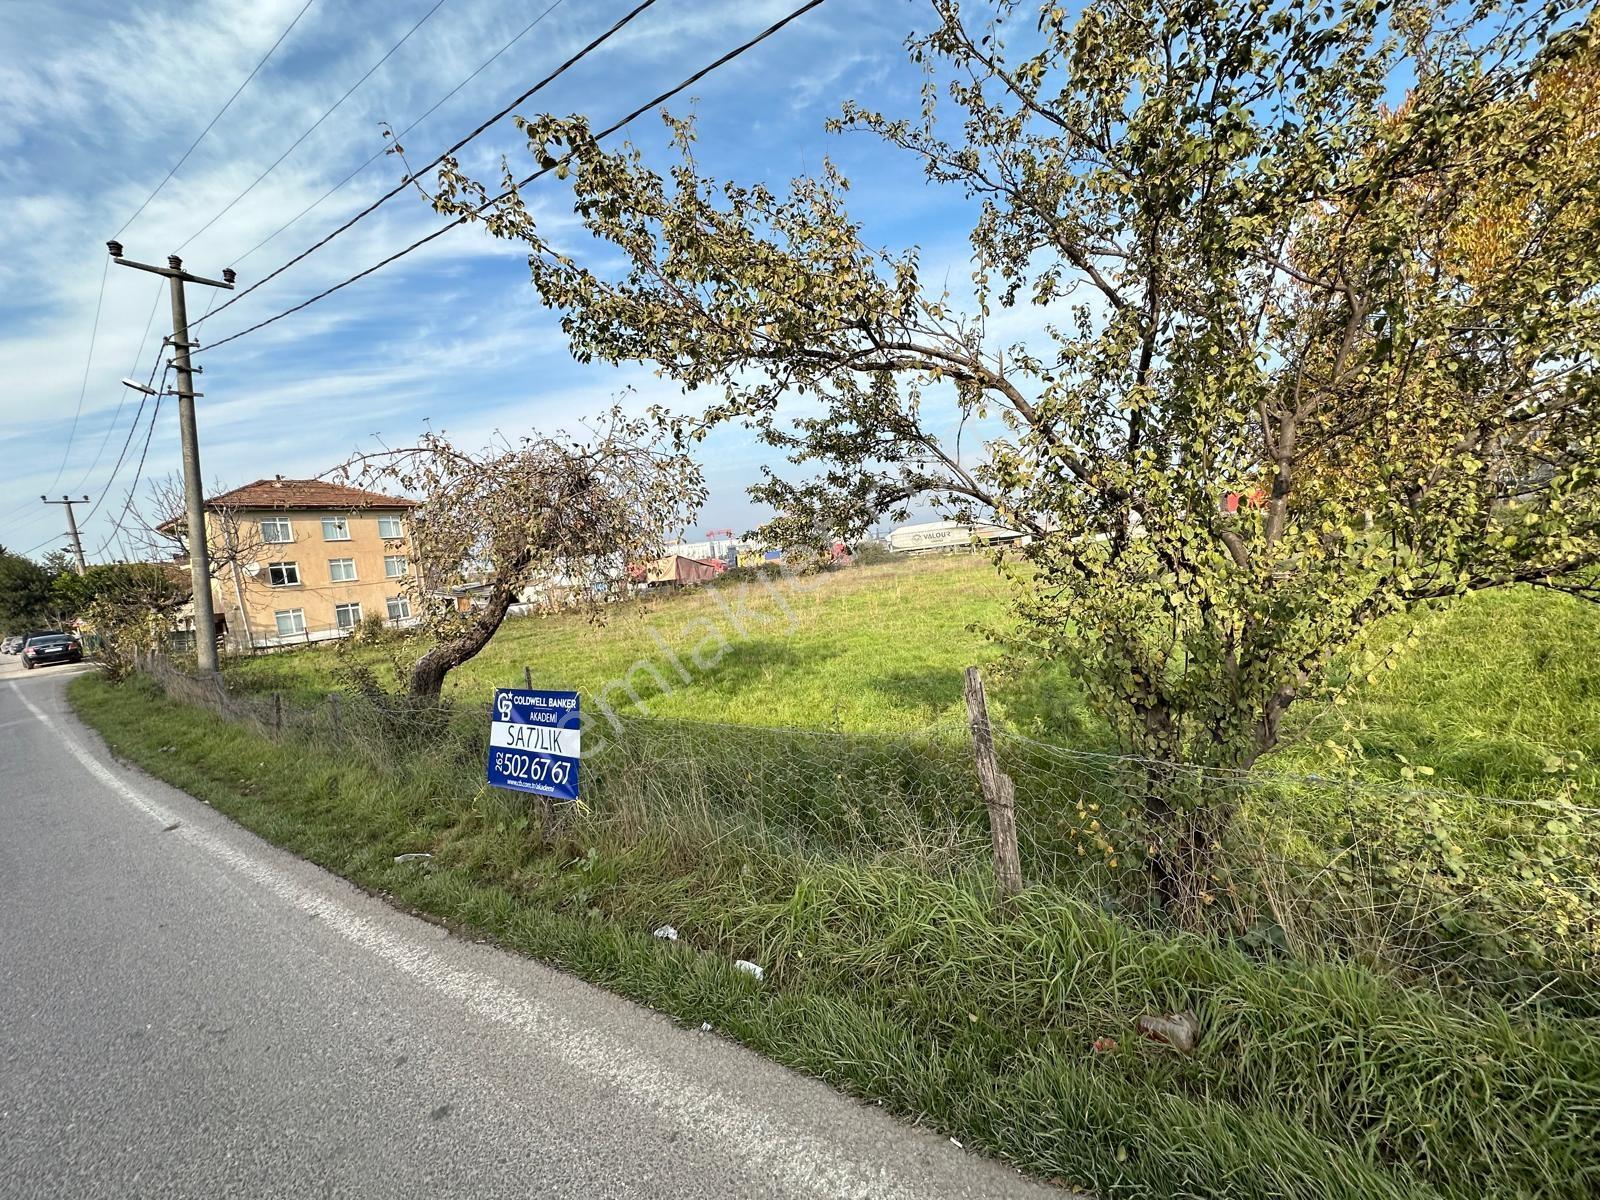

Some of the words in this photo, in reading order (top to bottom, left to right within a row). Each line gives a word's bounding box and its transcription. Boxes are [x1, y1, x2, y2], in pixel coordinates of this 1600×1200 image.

[513, 696, 547, 706] COLDWELL
[548, 698, 576, 709] BANKER
[530, 712, 557, 723] AKADEMİ
[507, 725, 562, 753] SATILIK
[495, 752, 504, 772] 262
[503, 754, 529, 778] 502
[531, 758, 551, 781] 67
[551, 761, 571, 785] 67
